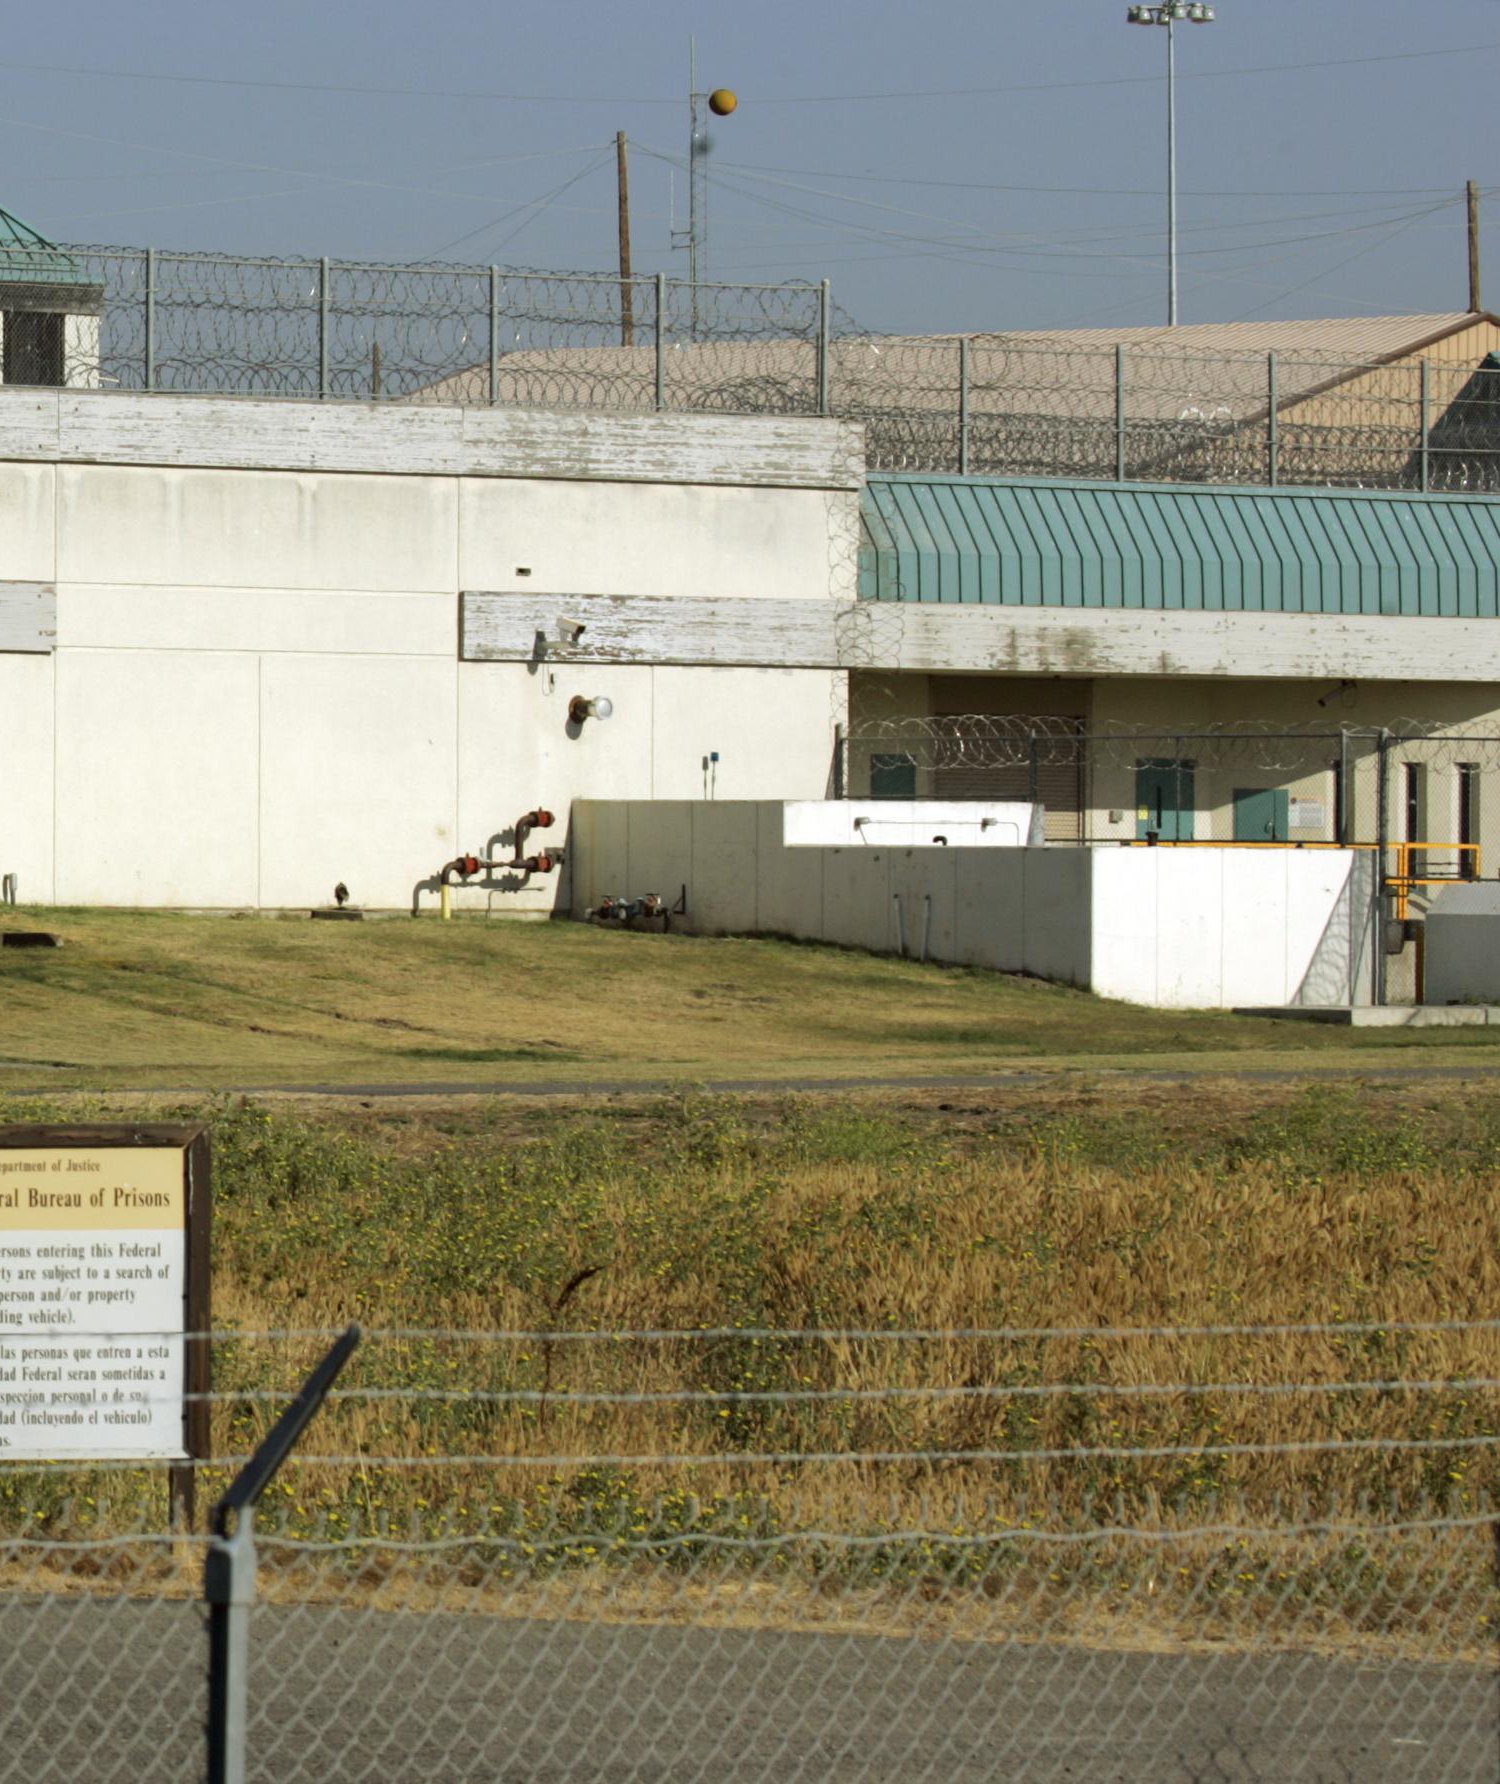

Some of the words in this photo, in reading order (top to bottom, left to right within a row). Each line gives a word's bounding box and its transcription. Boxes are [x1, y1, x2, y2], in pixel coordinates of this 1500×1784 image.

[51, 1160, 62, 1172] of
[66, 1160, 101, 1172] Justice
[28, 1187, 82, 1208] Bureau
[89, 1187, 106, 1208] of
[113, 1187, 171, 1208] Prisons
[36, 1243, 85, 1261] entering
[90, 1242, 113, 1258] this
[119, 1242, 161, 1258] Federal
[17, 1269, 37, 1281] are
[41, 1265, 81, 1282] subject
[86, 1267, 99, 1280] to
[103, 1269, 111, 1280] a
[115, 1264, 153, 1280] search
[157, 1264, 170, 1280] of
[40, 1287, 82, 1302] and/or
[87, 1288, 135, 1305] property
[28, 1309, 76, 1324] vehicle).
[0, 1345, 17, 1360] las
[21, 1348, 69, 1363] personas
[72, 1348, 92, 1363] que
[96, 1347, 132, 1359] entren
[136, 1348, 143, 1359] a
[147, 1346, 170, 1359] esta
[22, 1366, 62, 1382] Federal
[67, 1370, 97, 1381] seran
[101, 1365, 155, 1381] sometidas
[159, 1370, 166, 1381] a
[50, 1388, 97, 1406] personal
[101, 1392, 109, 1403] o
[112, 1388, 125, 1403] de
[21, 1410, 84, 1427] (incluyendo
[88, 1410, 98, 1425] el
[103, 1410, 153, 1427] vehiculo)
